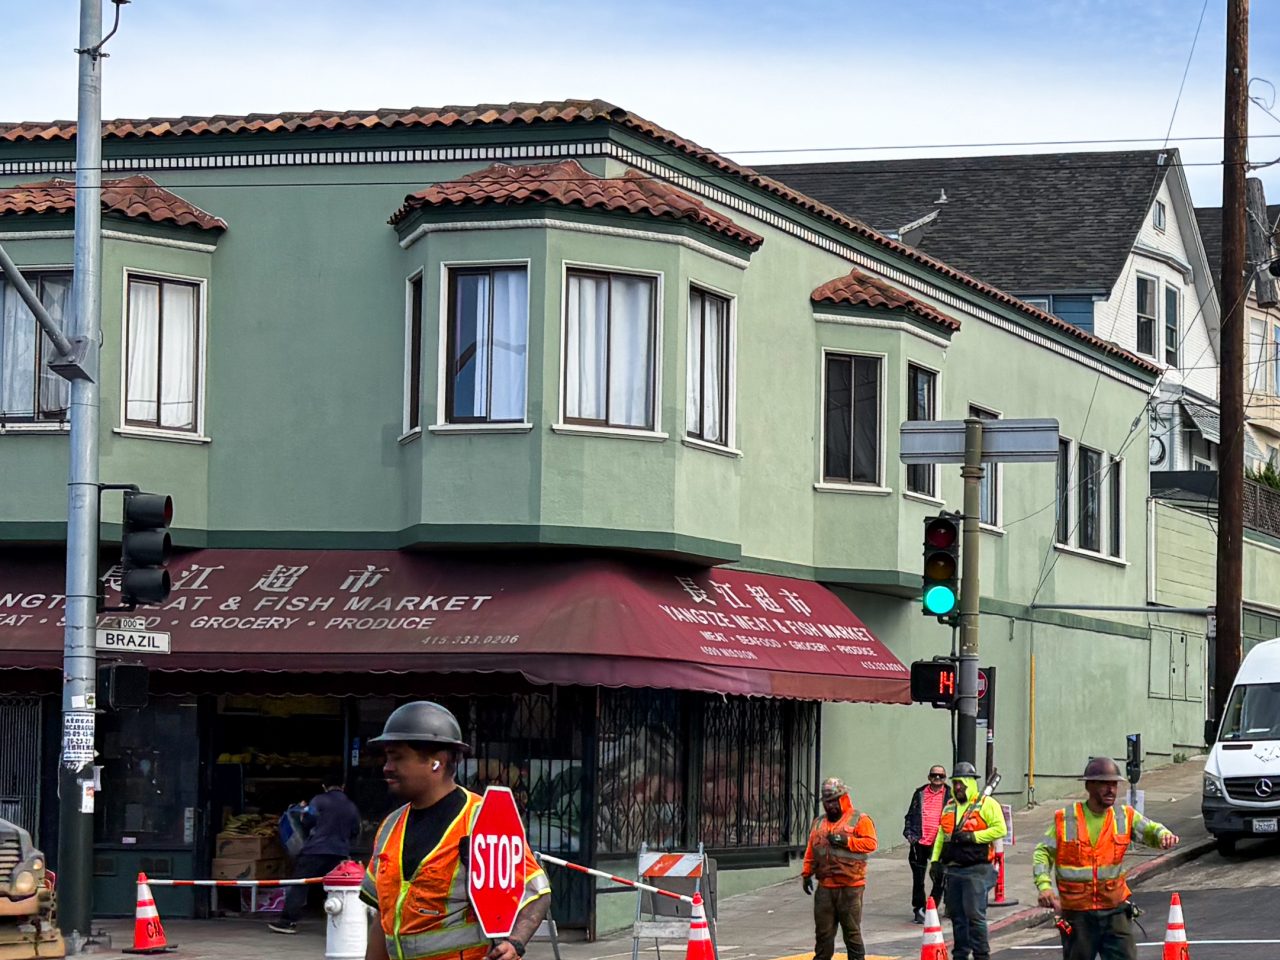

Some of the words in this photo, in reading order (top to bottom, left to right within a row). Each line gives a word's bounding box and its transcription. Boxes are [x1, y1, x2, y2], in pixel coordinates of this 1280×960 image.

[219, 596, 242, 611] &
[253, 596, 336, 611] FISH
[343, 595, 493, 611] MARKET
[190, 615, 299, 629] GROCERY
[324, 617, 436, 629] PRODUCE
[659, 605, 736, 628] YANGTZE
[731, 614, 775, 632] MEAT
[773, 619, 790, 633] &
[784, 619, 823, 637] FISH
[817, 623, 875, 641] MARKET
[105, 632, 160, 648] BRAZIL
[700, 630, 728, 642] MEAT
[735, 634, 781, 648] SEAFOOD
[788, 640, 831, 653] GROCERY
[836, 644, 878, 656] PRODUCE
[939, 671, 955, 695] 14
[472, 833, 523, 889] STOP
